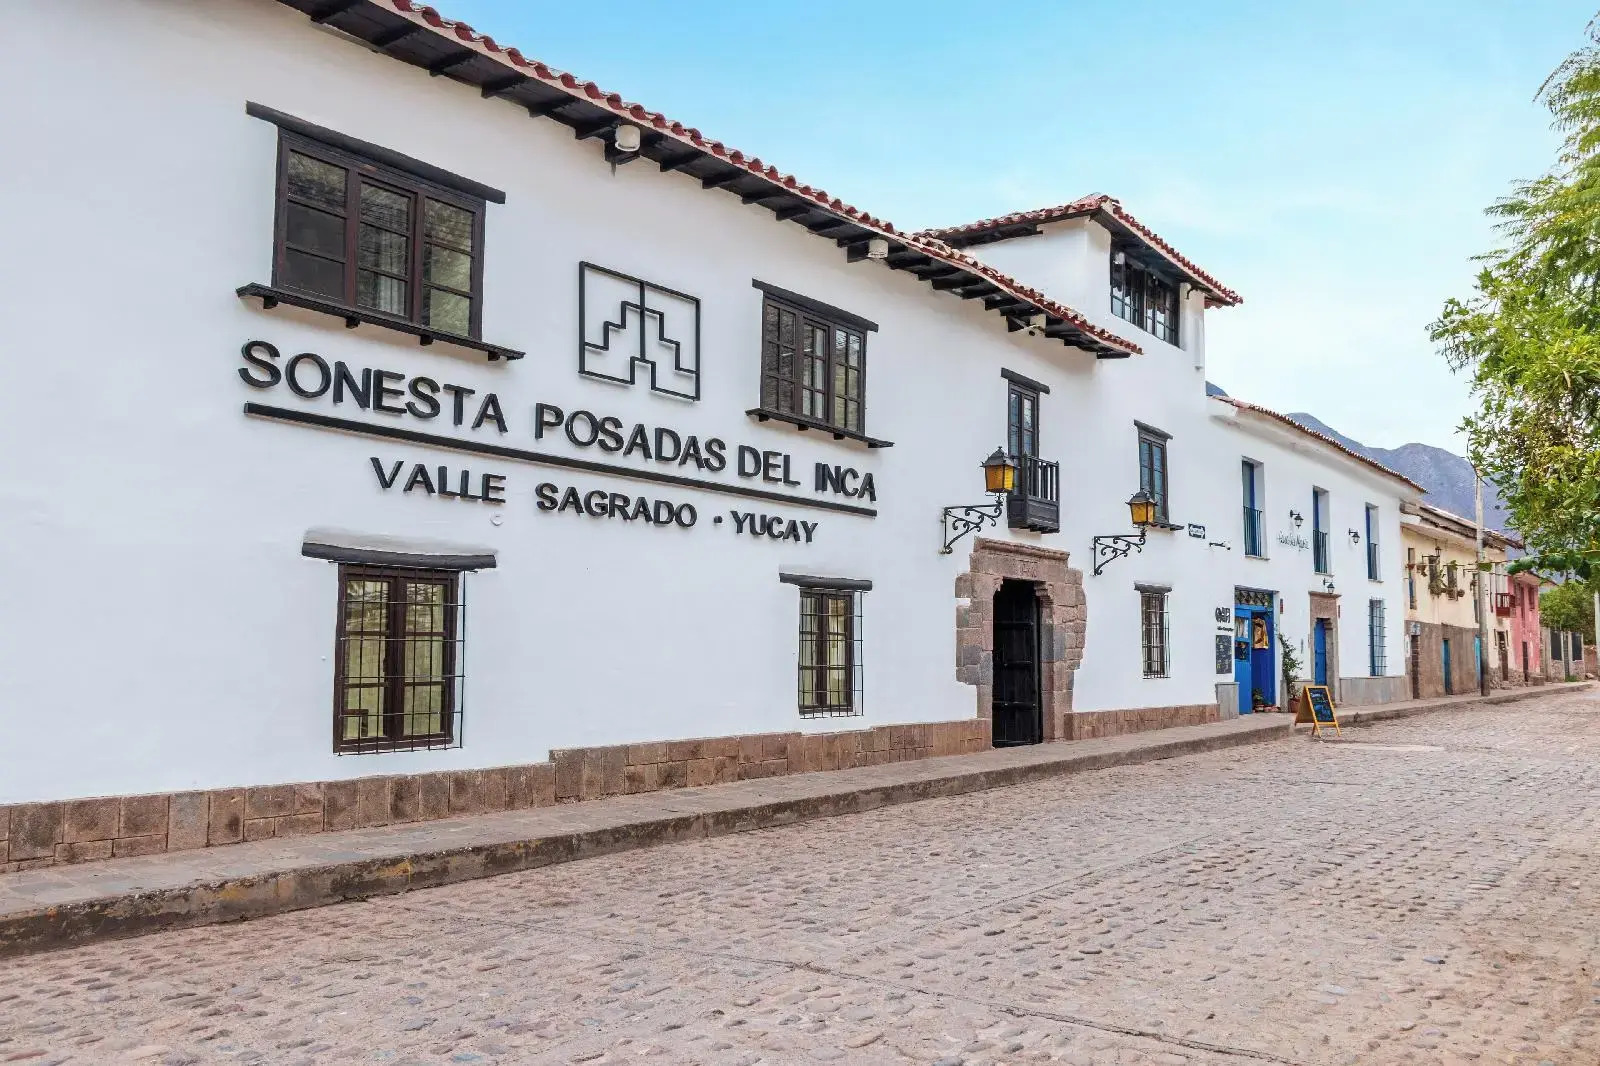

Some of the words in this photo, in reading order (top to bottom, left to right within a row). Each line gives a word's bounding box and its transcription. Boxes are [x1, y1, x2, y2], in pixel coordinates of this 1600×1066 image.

[237, 340, 509, 433] SONESTA
[535, 402, 727, 473] POSADAS
[737, 445, 801, 486] DEL
[814, 462, 877, 502] INCA
[370, 456, 507, 504] VALLE
[535, 482, 698, 529] SAGRADO
[730, 510, 819, 544] YUCAY
